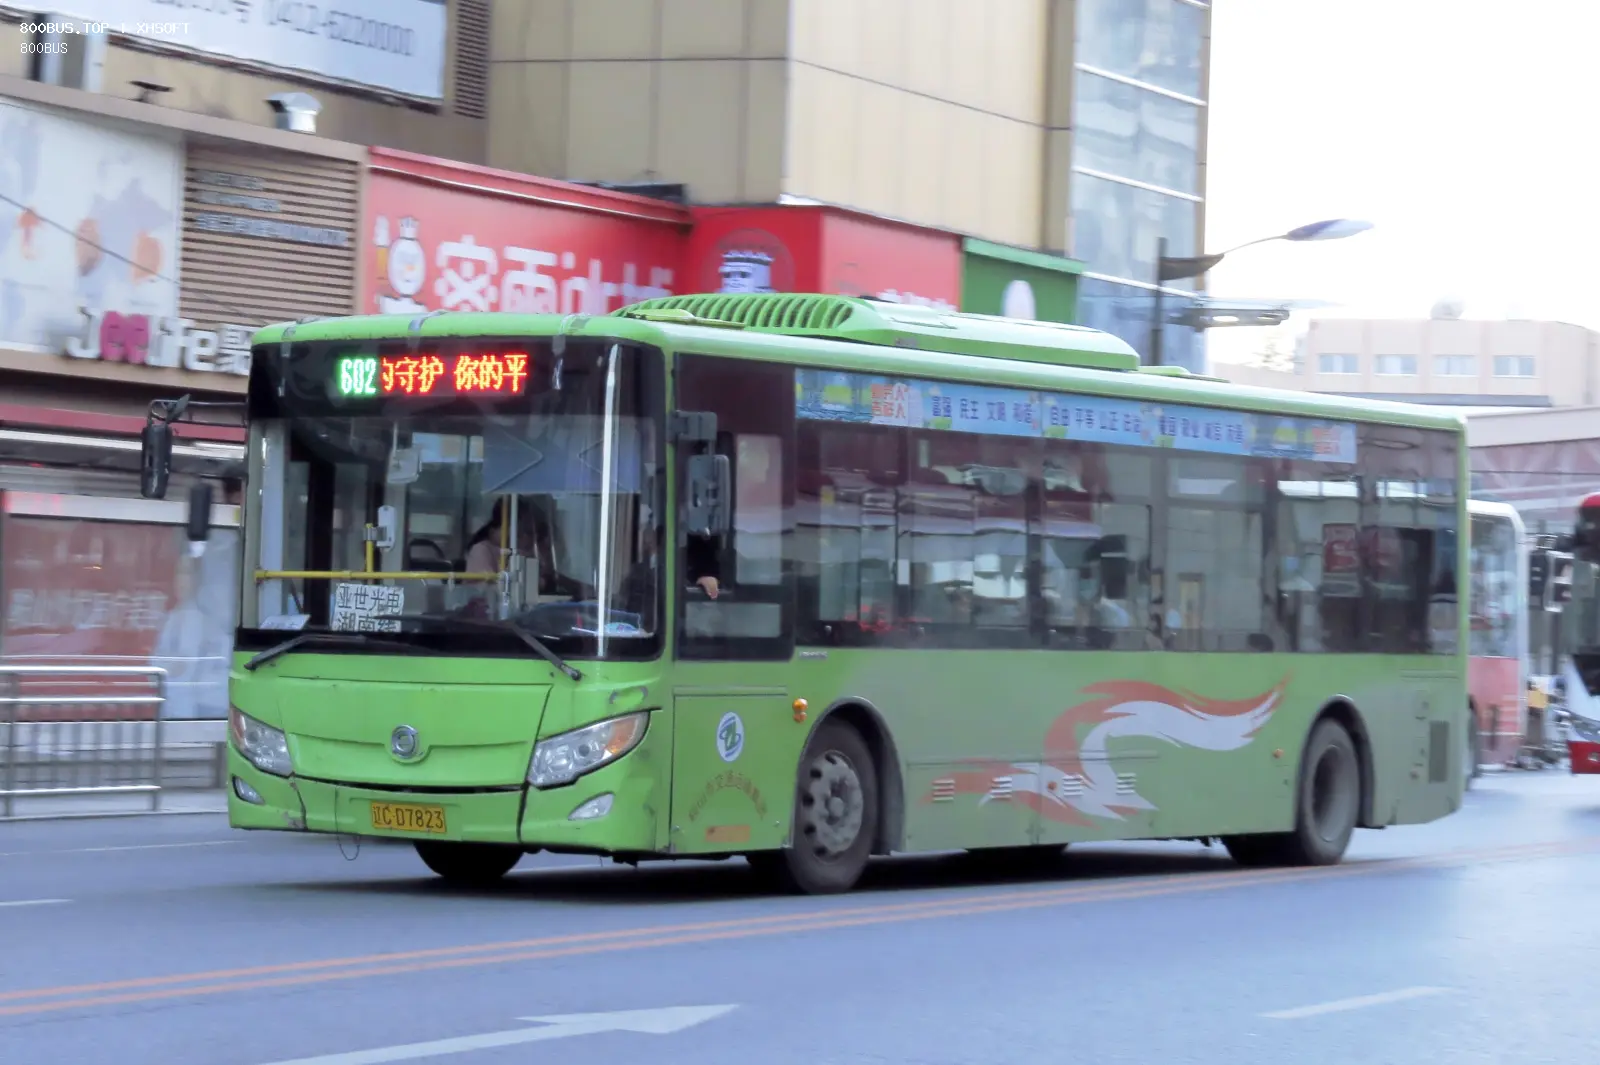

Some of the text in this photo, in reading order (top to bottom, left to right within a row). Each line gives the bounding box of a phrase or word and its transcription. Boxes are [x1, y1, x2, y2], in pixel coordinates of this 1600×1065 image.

[341, 358, 376, 394] 602
[454, 354, 528, 392] 你的平
[338, 586, 400, 614] 亚世光电
